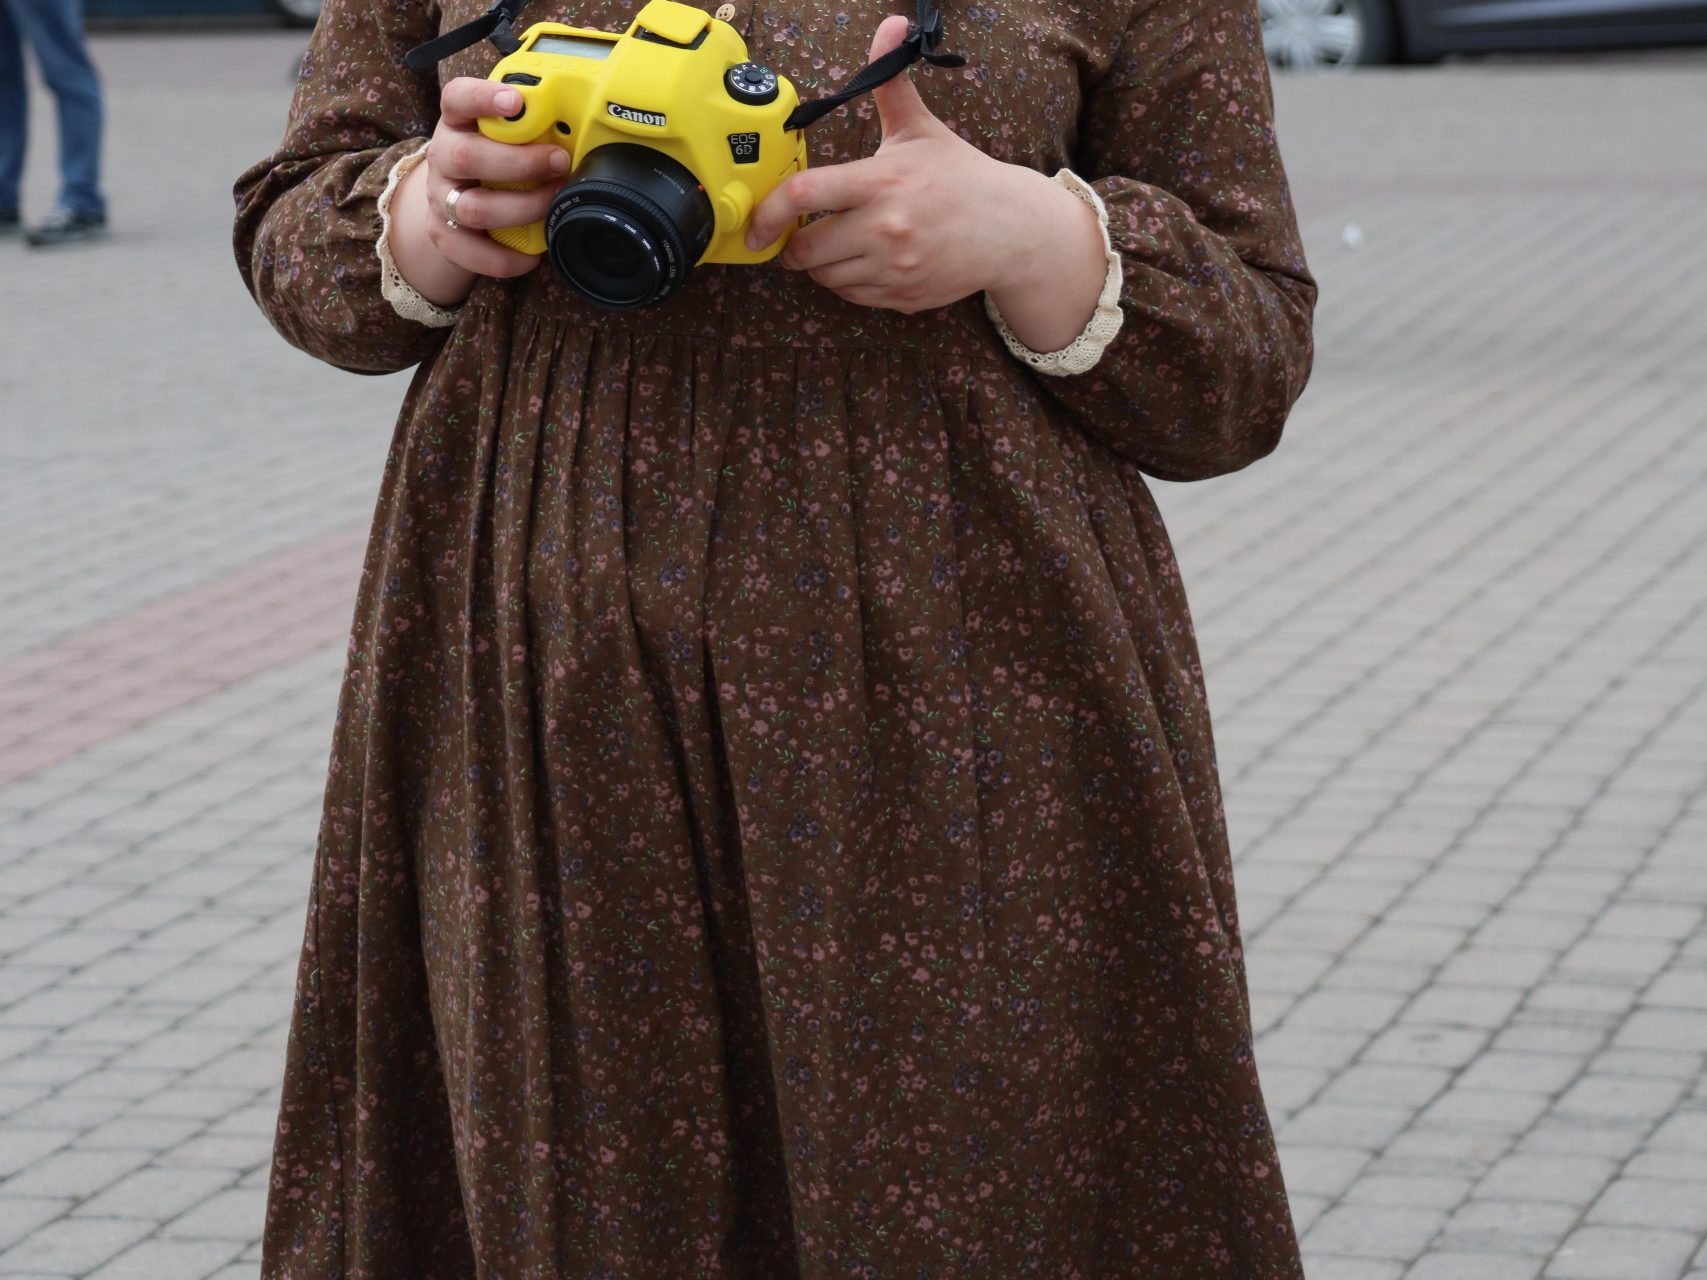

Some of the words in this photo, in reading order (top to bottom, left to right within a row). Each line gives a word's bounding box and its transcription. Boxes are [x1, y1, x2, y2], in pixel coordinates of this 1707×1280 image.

[608, 104, 666, 126] Canon
[731, 134, 757, 144] EOS
[735, 145, 753, 155] 6D
